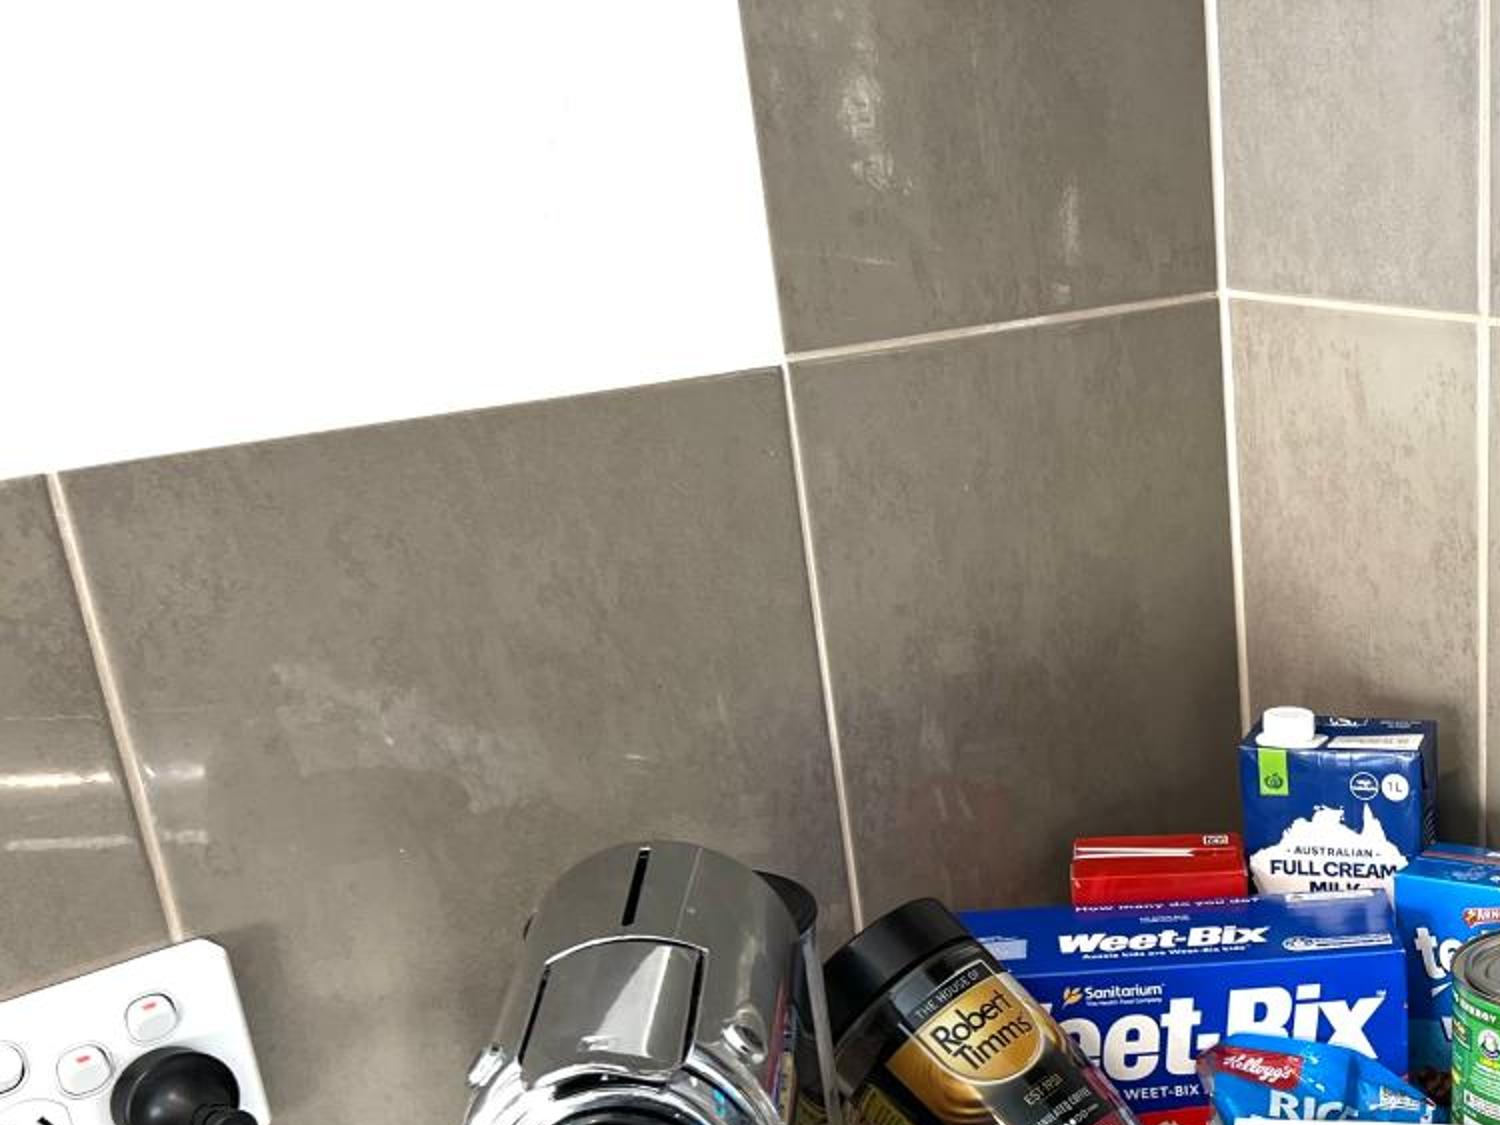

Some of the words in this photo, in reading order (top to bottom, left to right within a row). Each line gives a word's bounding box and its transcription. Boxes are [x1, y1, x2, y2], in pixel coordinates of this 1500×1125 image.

[1293, 846, 1373, 858] AUSTRALIAN
[1270, 859, 1321, 876] FULL
[1323, 861, 1398, 879] CREAM
[1075, 904, 1113, 913] How
[1119, 902, 1164, 911] many
[1169, 900, 1191, 908] do
[1195, 898, 1226, 907] you
[1058, 925, 1272, 955] Weet-Bix
[914, 999, 938, 1019] THE
[935, 977, 971, 1004] HOUSE
[1084, 984, 1163, 1000] Sanitarium
[930, 988, 1013, 1055] Robert
[1040, 983, 1386, 1082] eet-Bix
[951, 1015, 1033, 1071] Timms
[1223, 1056, 1294, 1083] Kellogg's
[1123, 1084, 1200, 1101] WEET-BIX
